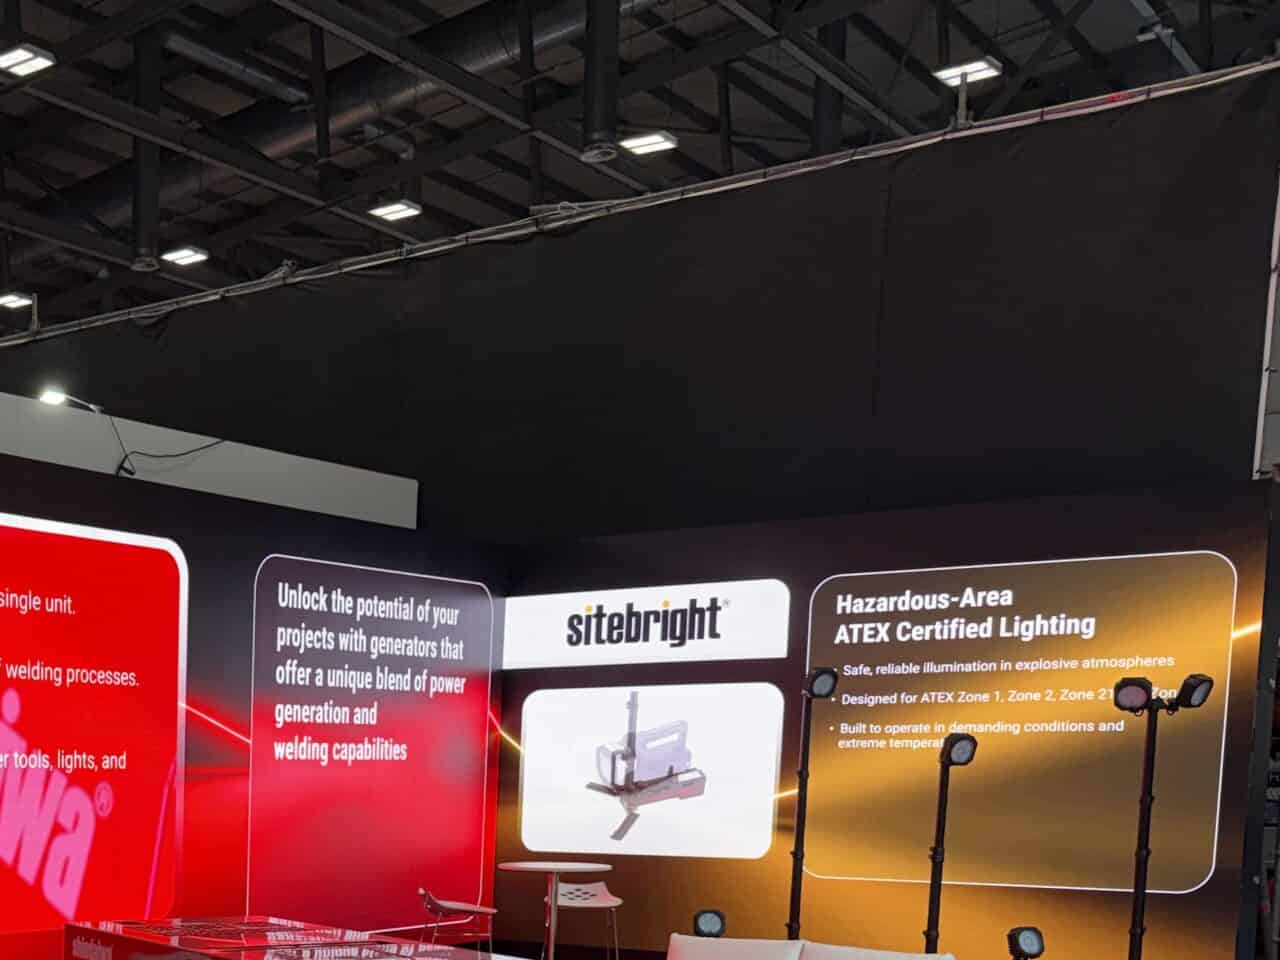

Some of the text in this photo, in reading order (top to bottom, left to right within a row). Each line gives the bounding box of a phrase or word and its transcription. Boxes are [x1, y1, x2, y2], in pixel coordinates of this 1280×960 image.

[45, 594, 76, 614] unit.
[278, 582, 460, 629] Unlock the potential of your
[836, 587, 1013, 615] Hazardous-Area
[276, 623, 464, 660] projects with generators that
[834, 614, 1096, 644] ATEX Certified Lighting
[5, 658, 62, 686] welding
[66, 669, 140, 688] processes.
[275, 659, 466, 698] offer a unique blend of power
[843, 656, 1176, 676] Safe, reliable illumination in explosive atmospheres
[842, 693, 897, 707] Designed
[900, 692, 917, 704] for
[920, 692, 954, 704] ATEX
[958, 691, 990, 703] Zone
[1008, 690, 1041, 702] Zone
[1060, 688, 1094, 701] Zone
[1151, 688, 1178, 700] Zon
[275, 700, 378, 728] generation and
[840, 720, 1125, 736] Built to operate in demanding conditions and
[274, 736, 408, 766] welding capabilities
[838, 738, 945, 750] extreme temperat
[13, 749, 53, 772] tools,
[57, 749, 98, 772] lights,
[101, 751, 127, 769] and
